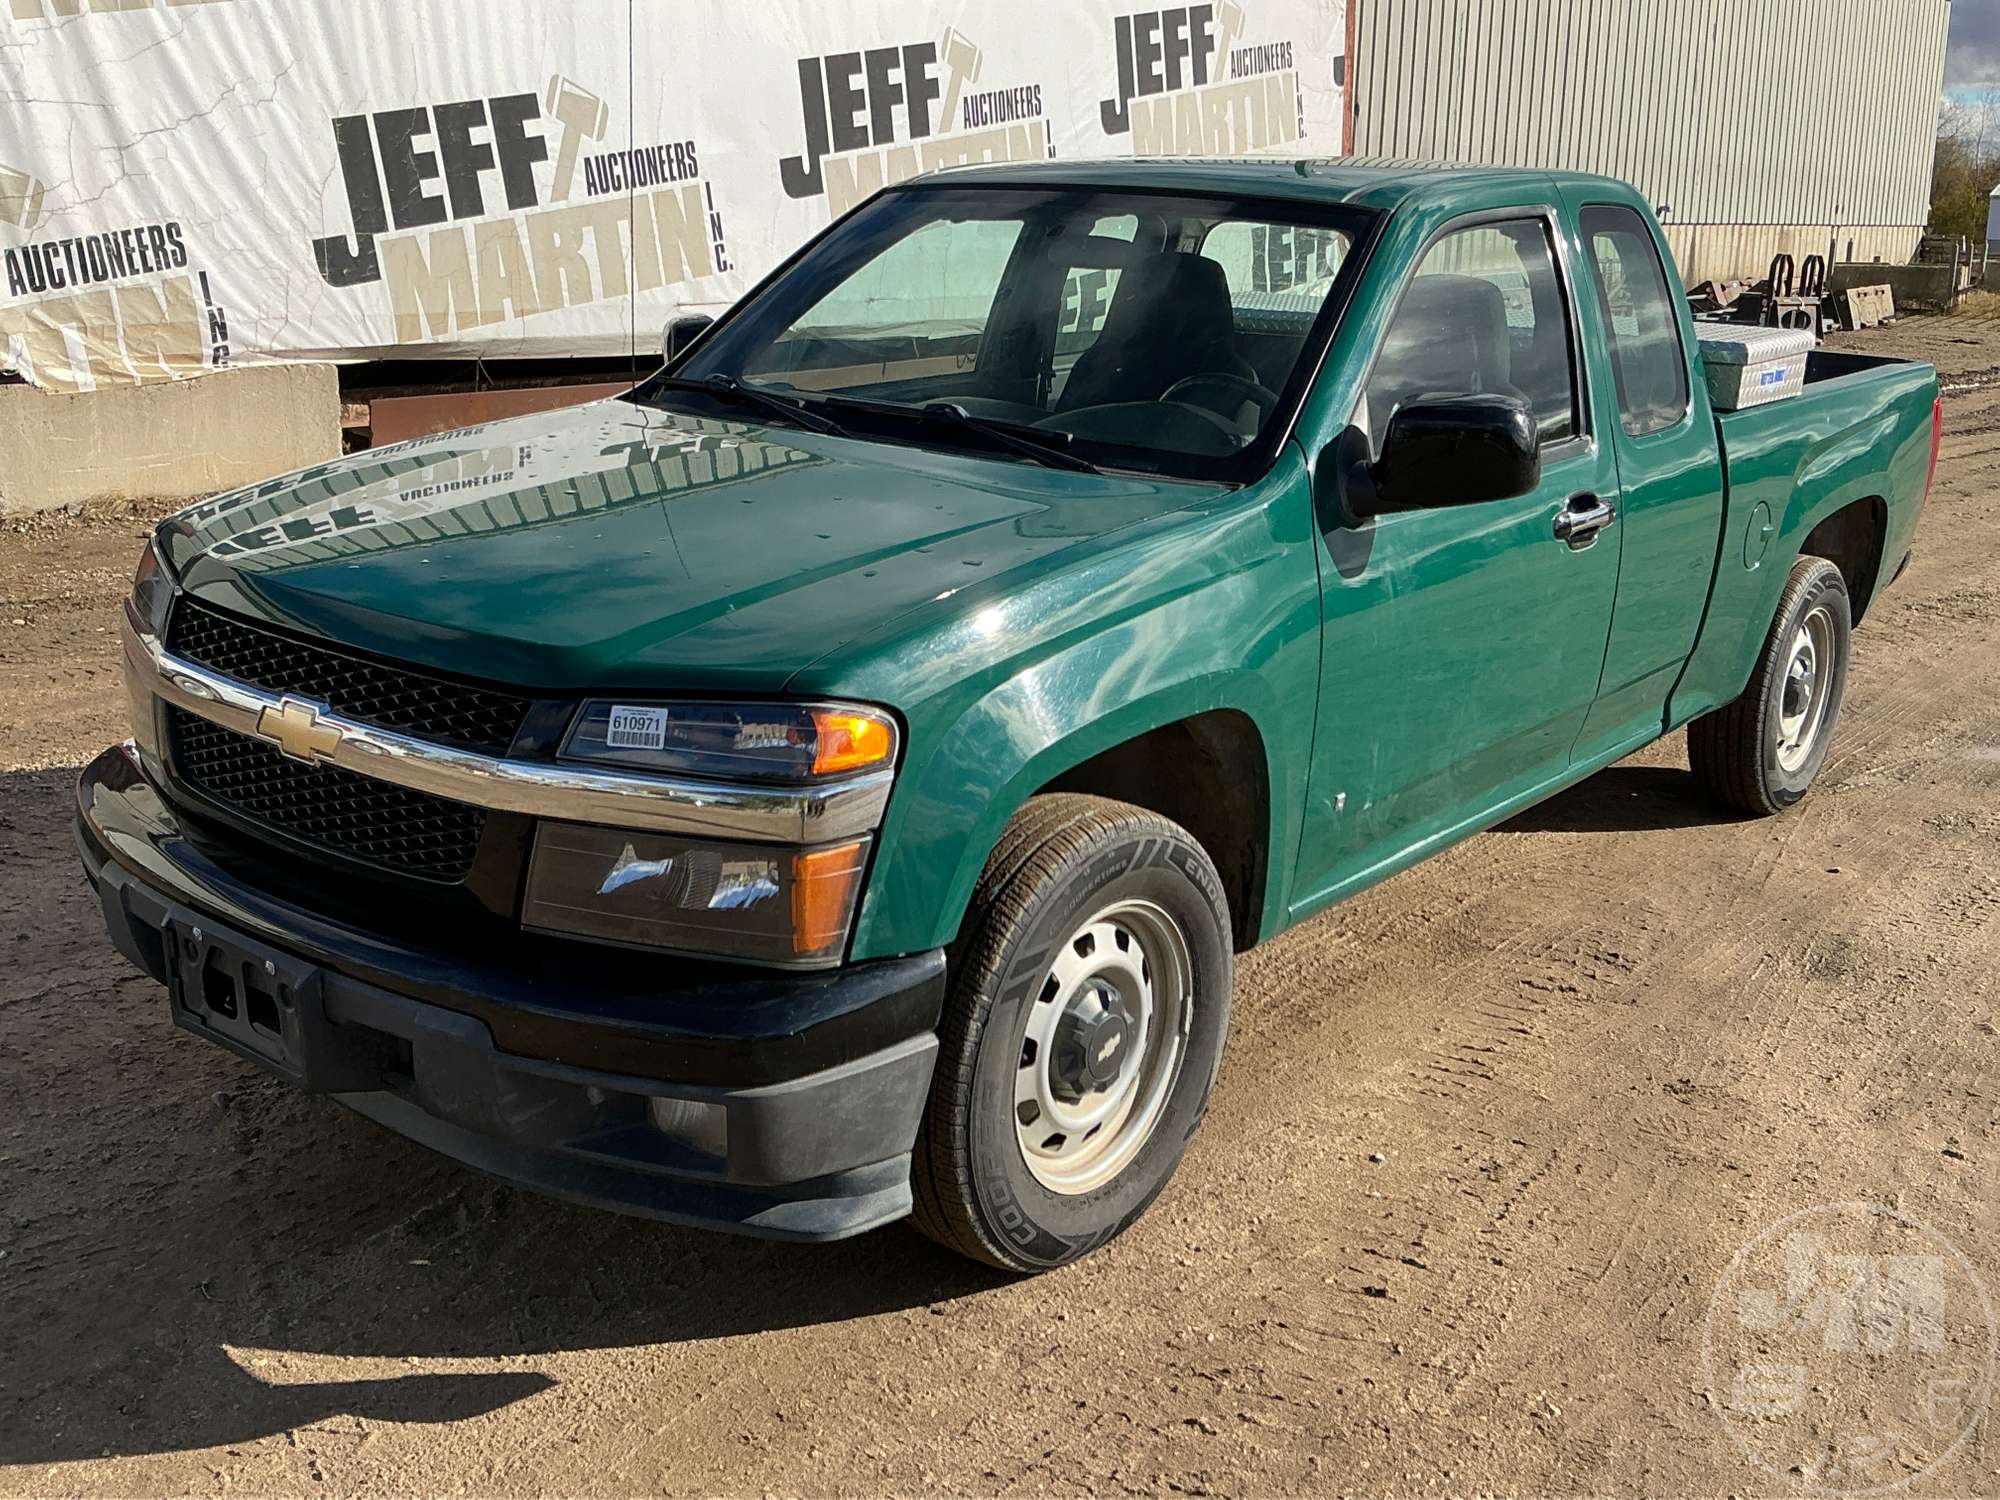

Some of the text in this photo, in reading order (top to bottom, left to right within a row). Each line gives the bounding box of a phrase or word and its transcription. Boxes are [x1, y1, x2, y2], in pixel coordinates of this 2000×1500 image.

[1100, 4, 1215, 136] JEFF
[1230, 41, 1293, 79] AUCTIONEERS
[780, 41, 940, 200] JEFF
[963, 84, 1042, 130] AUCTIONEERS
[1130, 72, 1297, 157] MARTIN
[312, 92, 549, 288] JEFF
[584, 140, 699, 197] AUCTIONEERS
[4, 222, 188, 297] AUCTIONEERS
[380, 185, 713, 344] MARTIN
[613, 715, 660, 732] 610971
